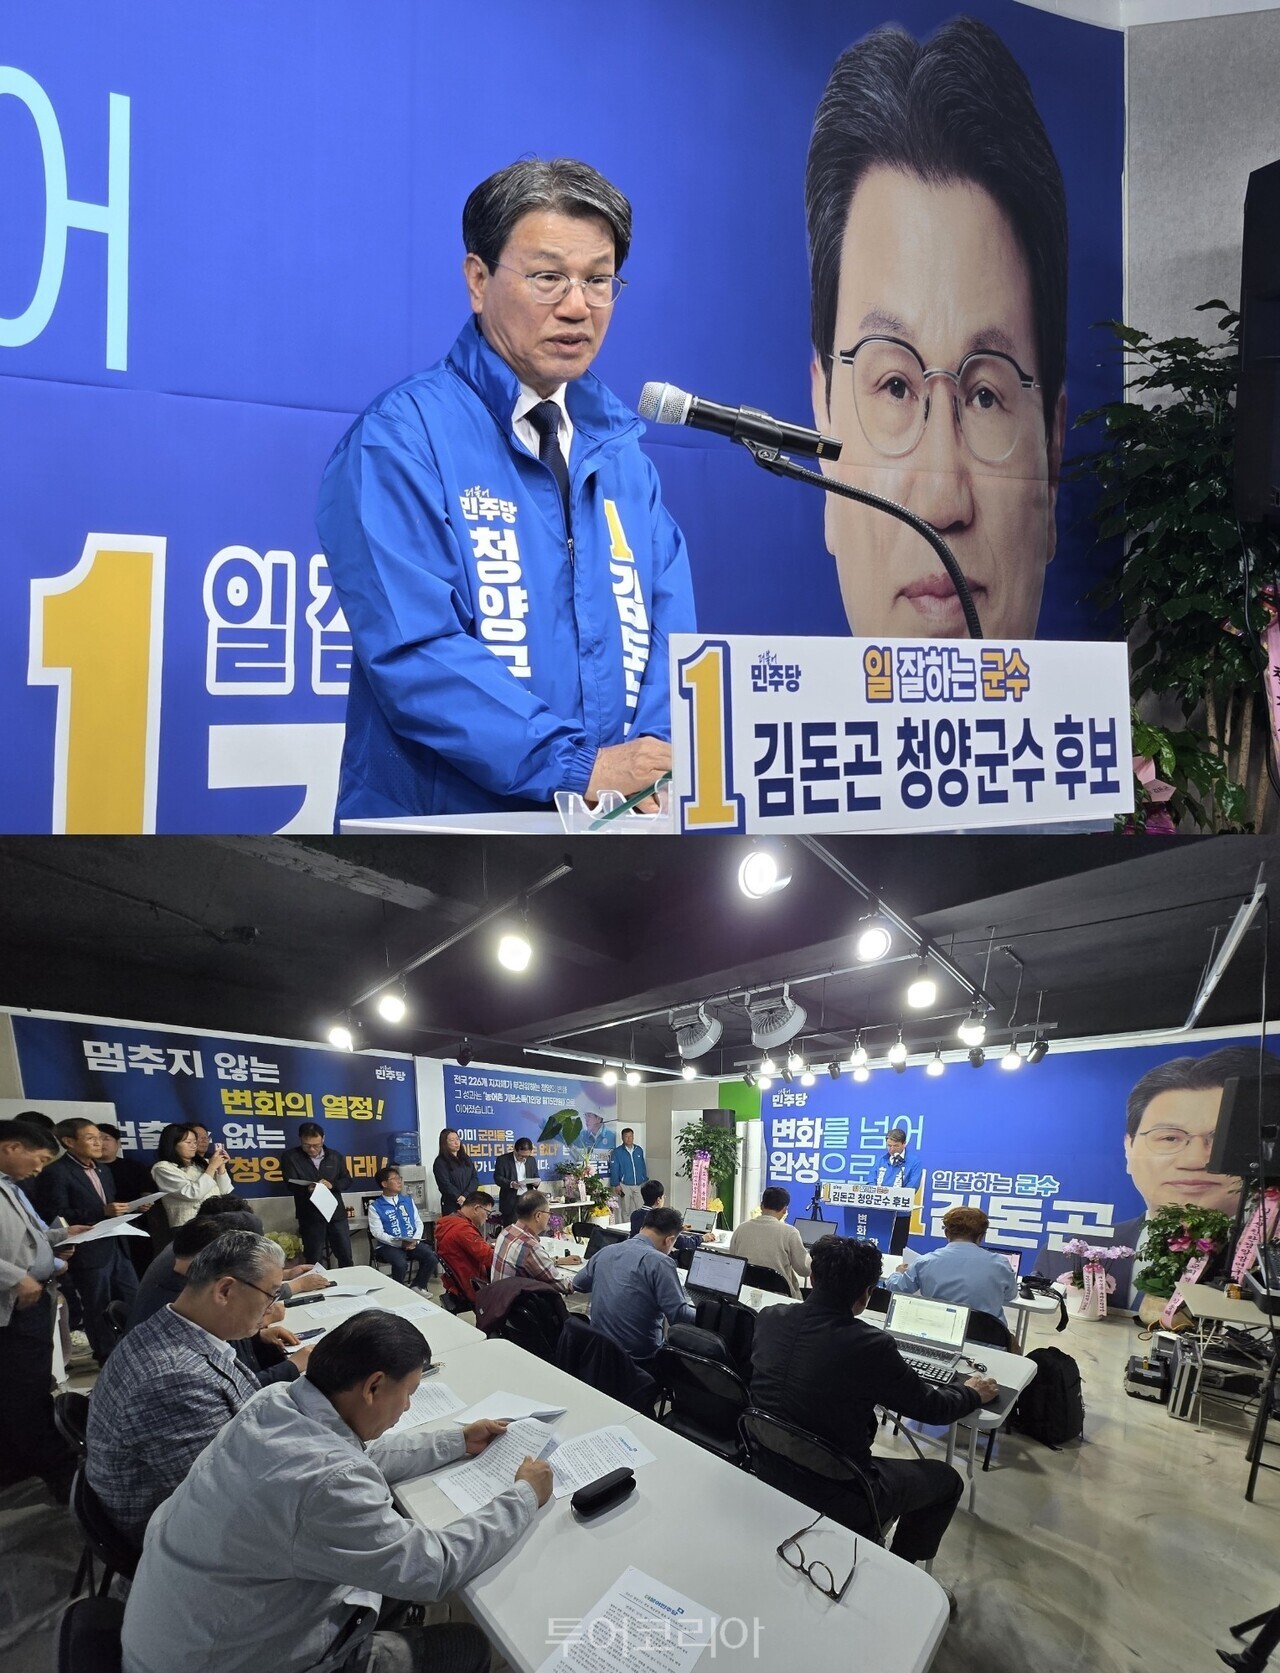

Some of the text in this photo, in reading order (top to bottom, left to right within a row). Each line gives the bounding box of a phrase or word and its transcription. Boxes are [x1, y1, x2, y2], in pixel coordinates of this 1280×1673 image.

[459, 496, 517, 524] 민주당
[604, 499, 635, 562] 1
[27, 532, 167, 834] 1
[751, 664, 802, 693] 민주당
[863, 645, 1030, 703] 일 잘하는 군수
[678, 640, 746, 834] 1
[754, 714, 1121, 817] 김돈곤 청양군수 후보
[82, 1040, 280, 1084] 멈추지 않는
[375, 1069, 406, 1082] 민주당
[453, 1074, 467, 1085] 전국
[468, 1076, 488, 1087] 226개
[454, 1089, 462, 1099] 그
[220, 1088, 384, 1121] 변화의 열정!
[772, 1093, 808, 1108] 민주당
[222, 1122, 286, 1150] 없는
[457, 1129, 515, 1142] 이미 군민들은
[772, 1115, 924, 1150] 변화를 넘어
[494, 1144, 505, 1155] 더
[769, 1151, 876, 1185] 완성으로
[932, 1170, 1060, 1196] 일 잘하는 군수
[833, 1191, 910, 1208] 김돈곤 청양군수 후보
